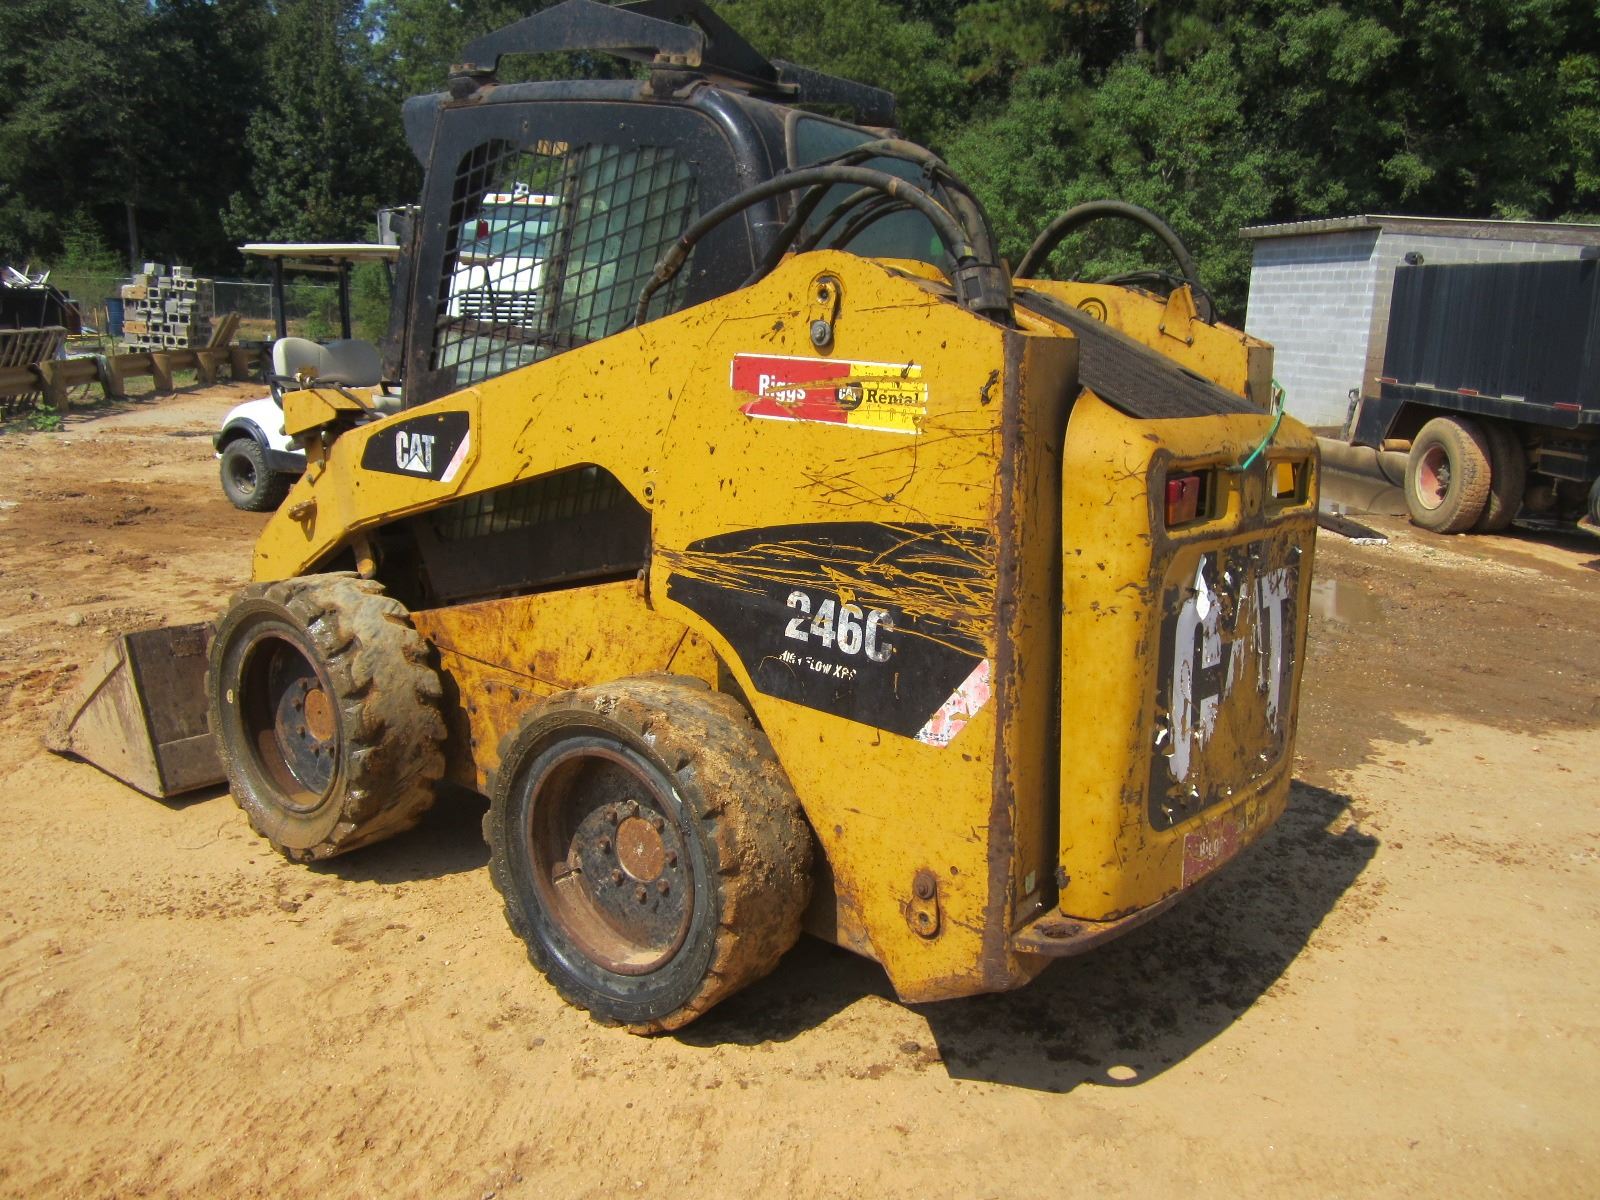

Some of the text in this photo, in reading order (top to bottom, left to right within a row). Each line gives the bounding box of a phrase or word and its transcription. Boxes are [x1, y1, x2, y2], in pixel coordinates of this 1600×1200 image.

[866, 388, 919, 406] Rental
[396, 430, 434, 473] CAT
[784, 590, 894, 663] 246C
